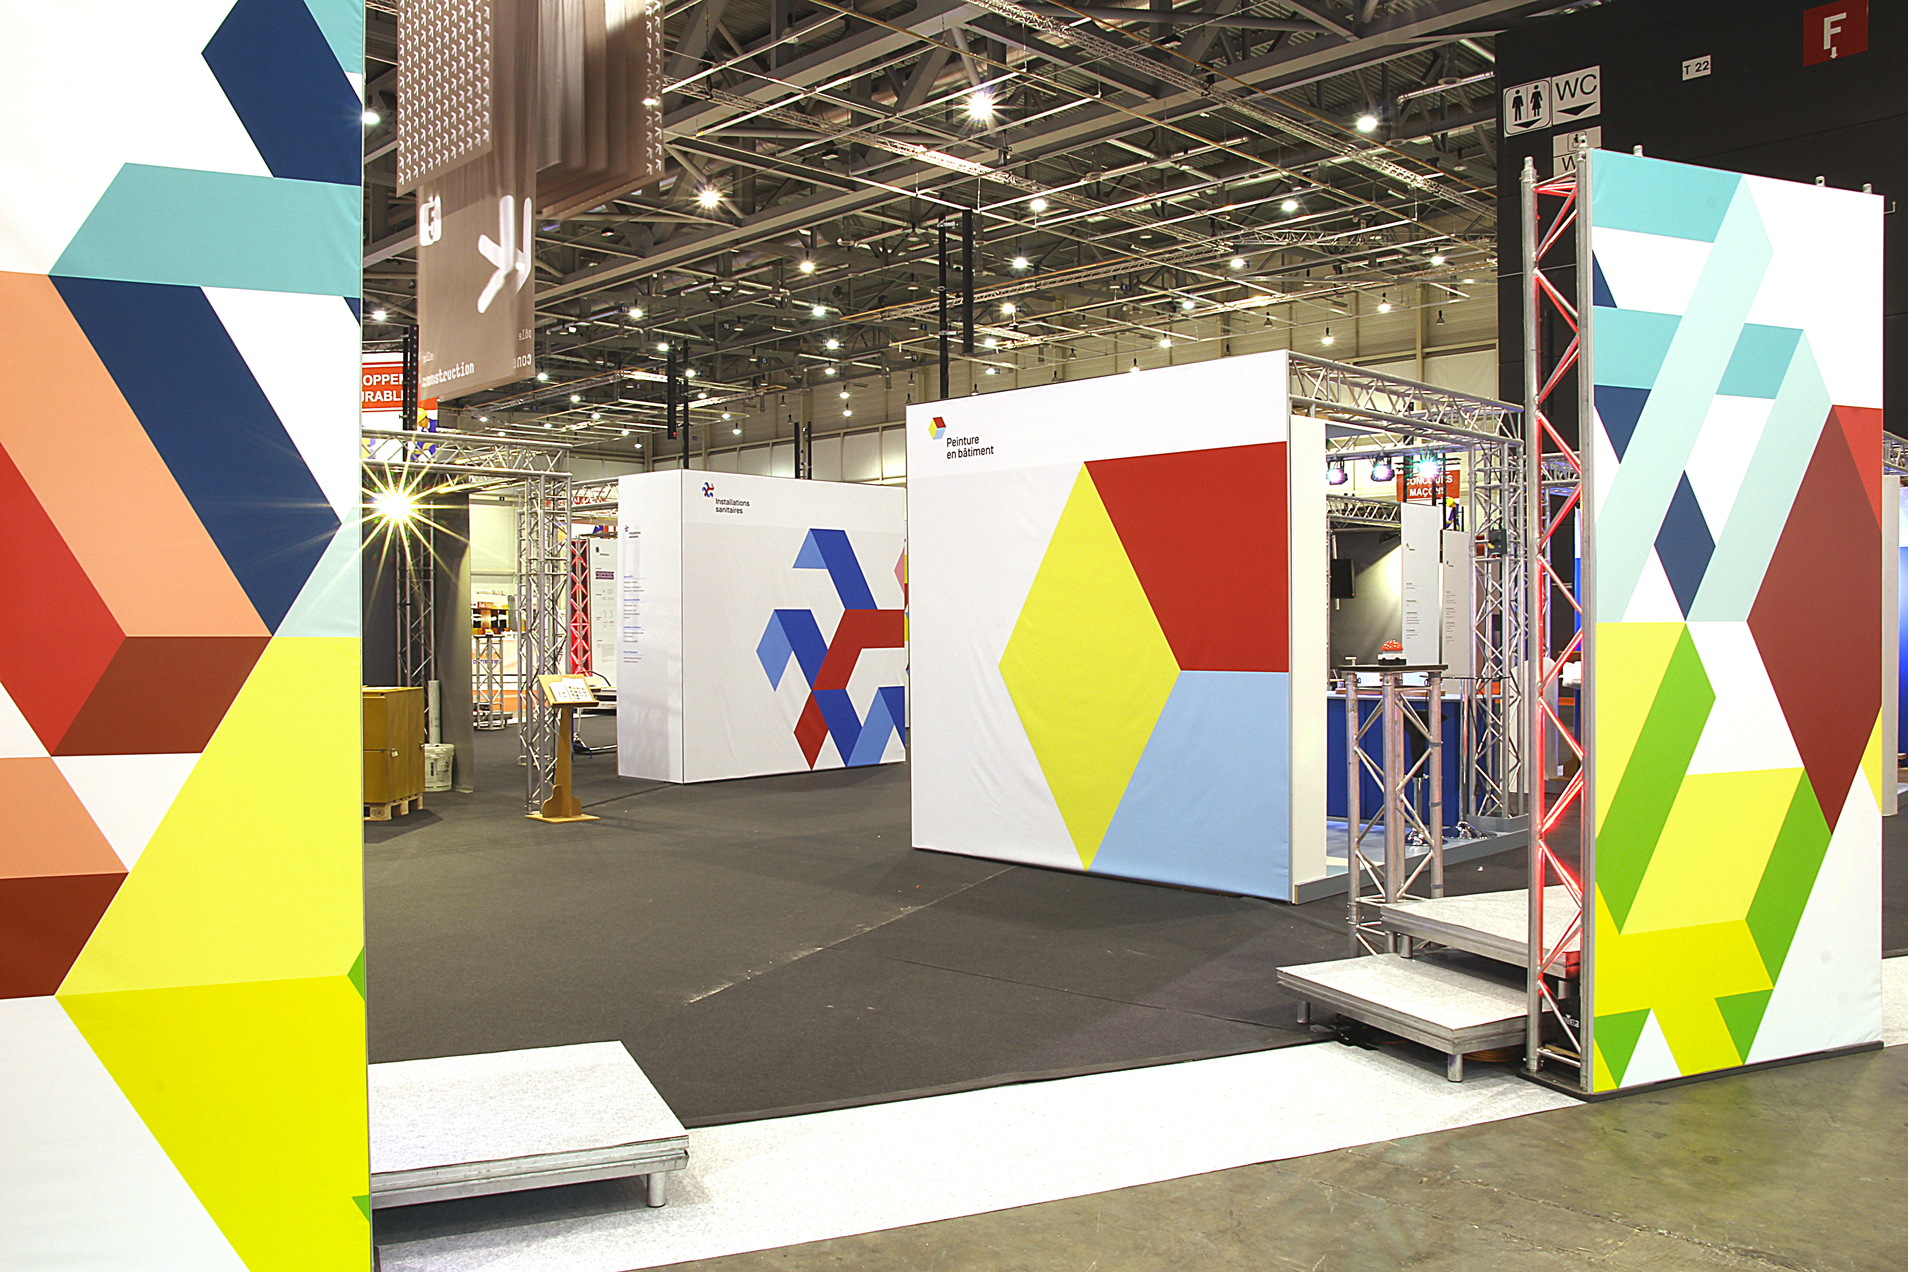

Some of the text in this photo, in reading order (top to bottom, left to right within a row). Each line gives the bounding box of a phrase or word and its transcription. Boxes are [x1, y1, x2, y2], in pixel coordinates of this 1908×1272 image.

[1824, 12, 1847, 50] F
[1684, 60, 1710, 75] T 22
[1556, 73, 1598, 101] WC
[1562, 156, 1577, 171] W
[421, 361, 475, 388] construction
[946, 436, 980, 447] Peinture
[946, 445, 995, 459] en bâtiment
[715, 498, 750, 507] Installations
[715, 506, 743, 514] sanitaires
